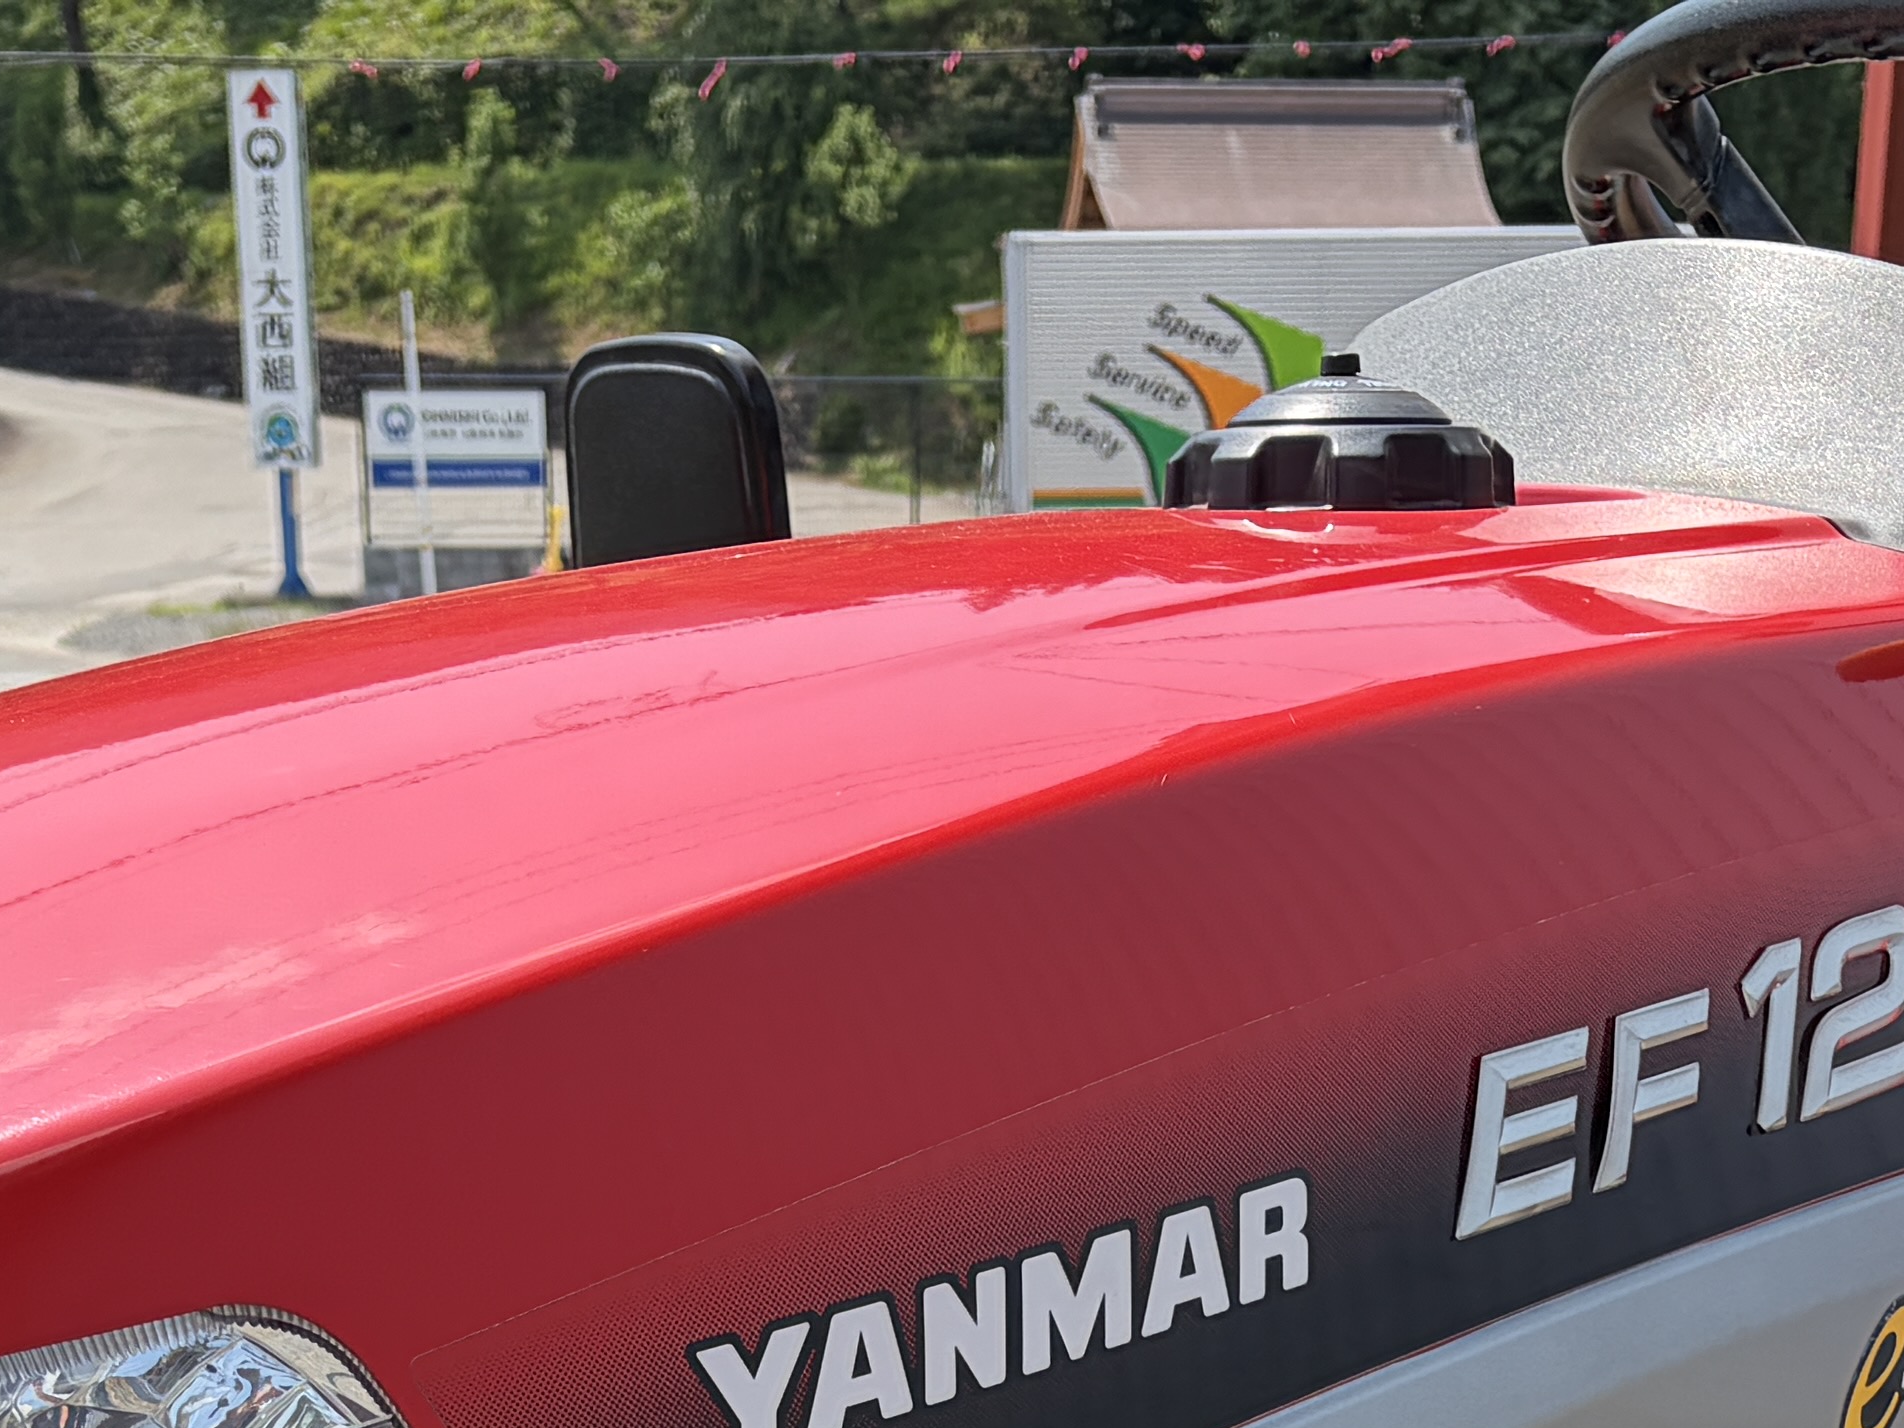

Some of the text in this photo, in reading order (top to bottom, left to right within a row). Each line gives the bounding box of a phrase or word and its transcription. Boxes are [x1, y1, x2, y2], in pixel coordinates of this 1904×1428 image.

[251, 176, 297, 391] 株式会社 大西組
[1147, 302, 1244, 357] Speed
[1087, 352, 1192, 411] Service
[1454, 986, 1711, 1240] EF
